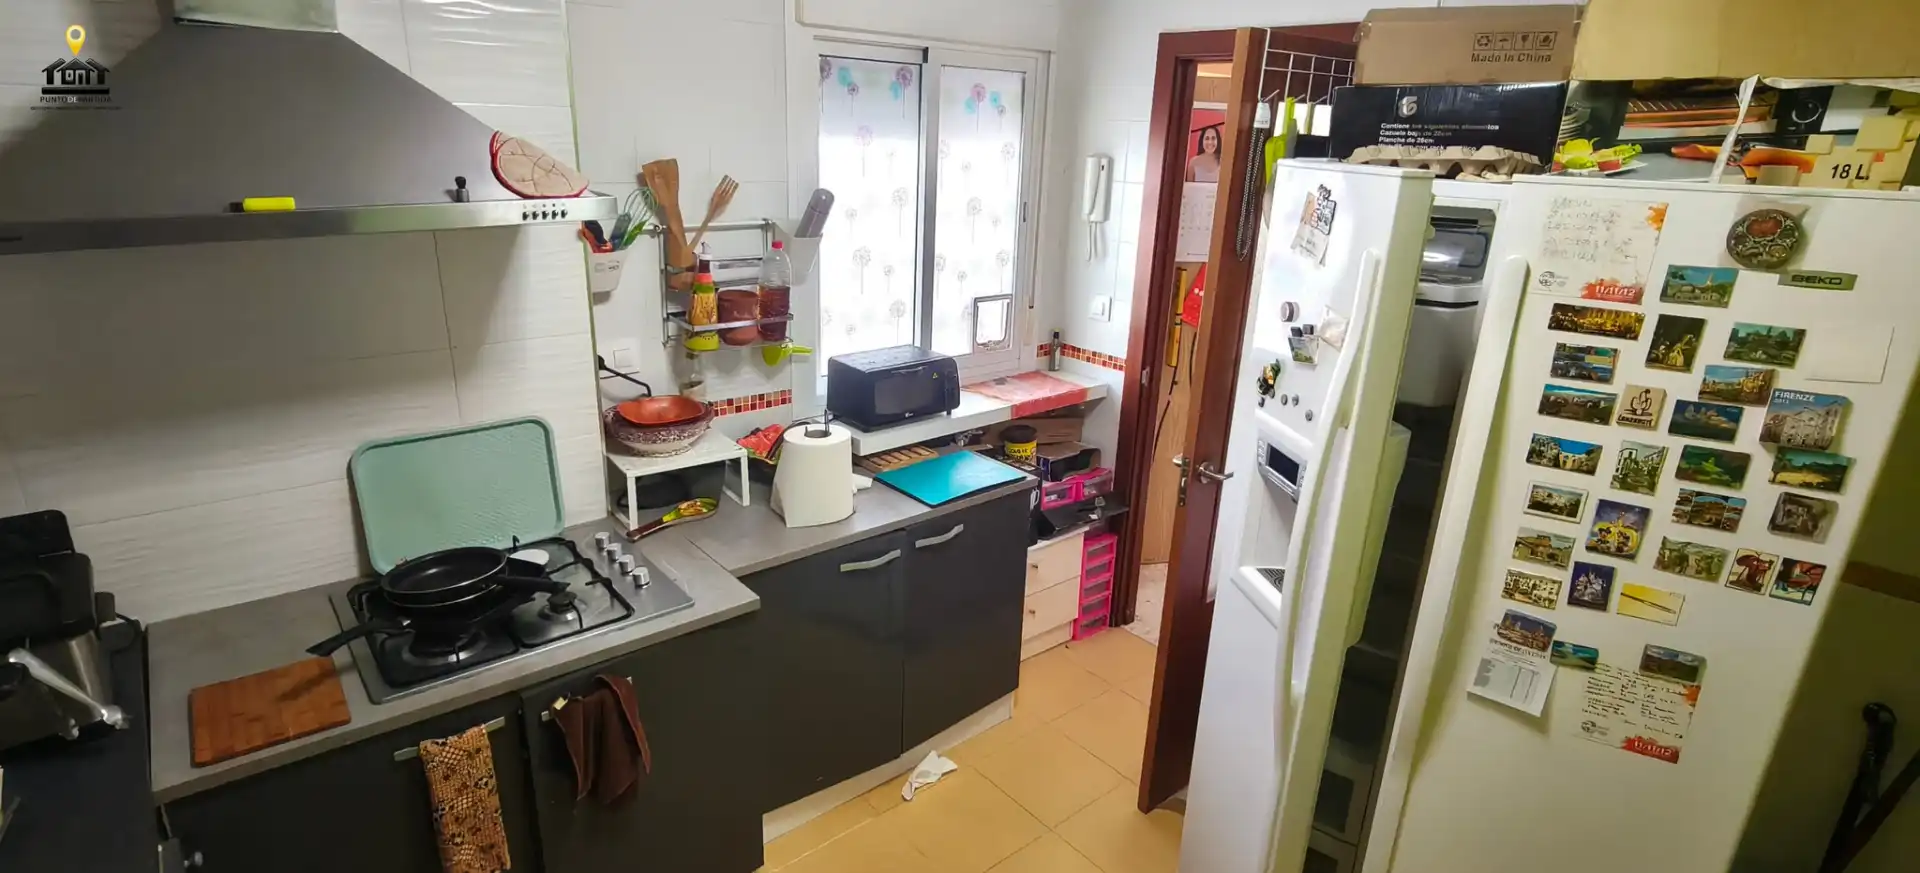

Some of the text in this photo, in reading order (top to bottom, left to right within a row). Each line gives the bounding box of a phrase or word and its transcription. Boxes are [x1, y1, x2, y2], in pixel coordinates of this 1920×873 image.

[1470, 52, 1501, 63] Made
[1517, 52, 1552, 63] China
[1830, 163, 1852, 180] 18
[1791, 274, 1842, 286] BEKO
[1595, 285, 1636, 297] 11/11/12
[1774, 390, 1816, 403] FIRENZE
